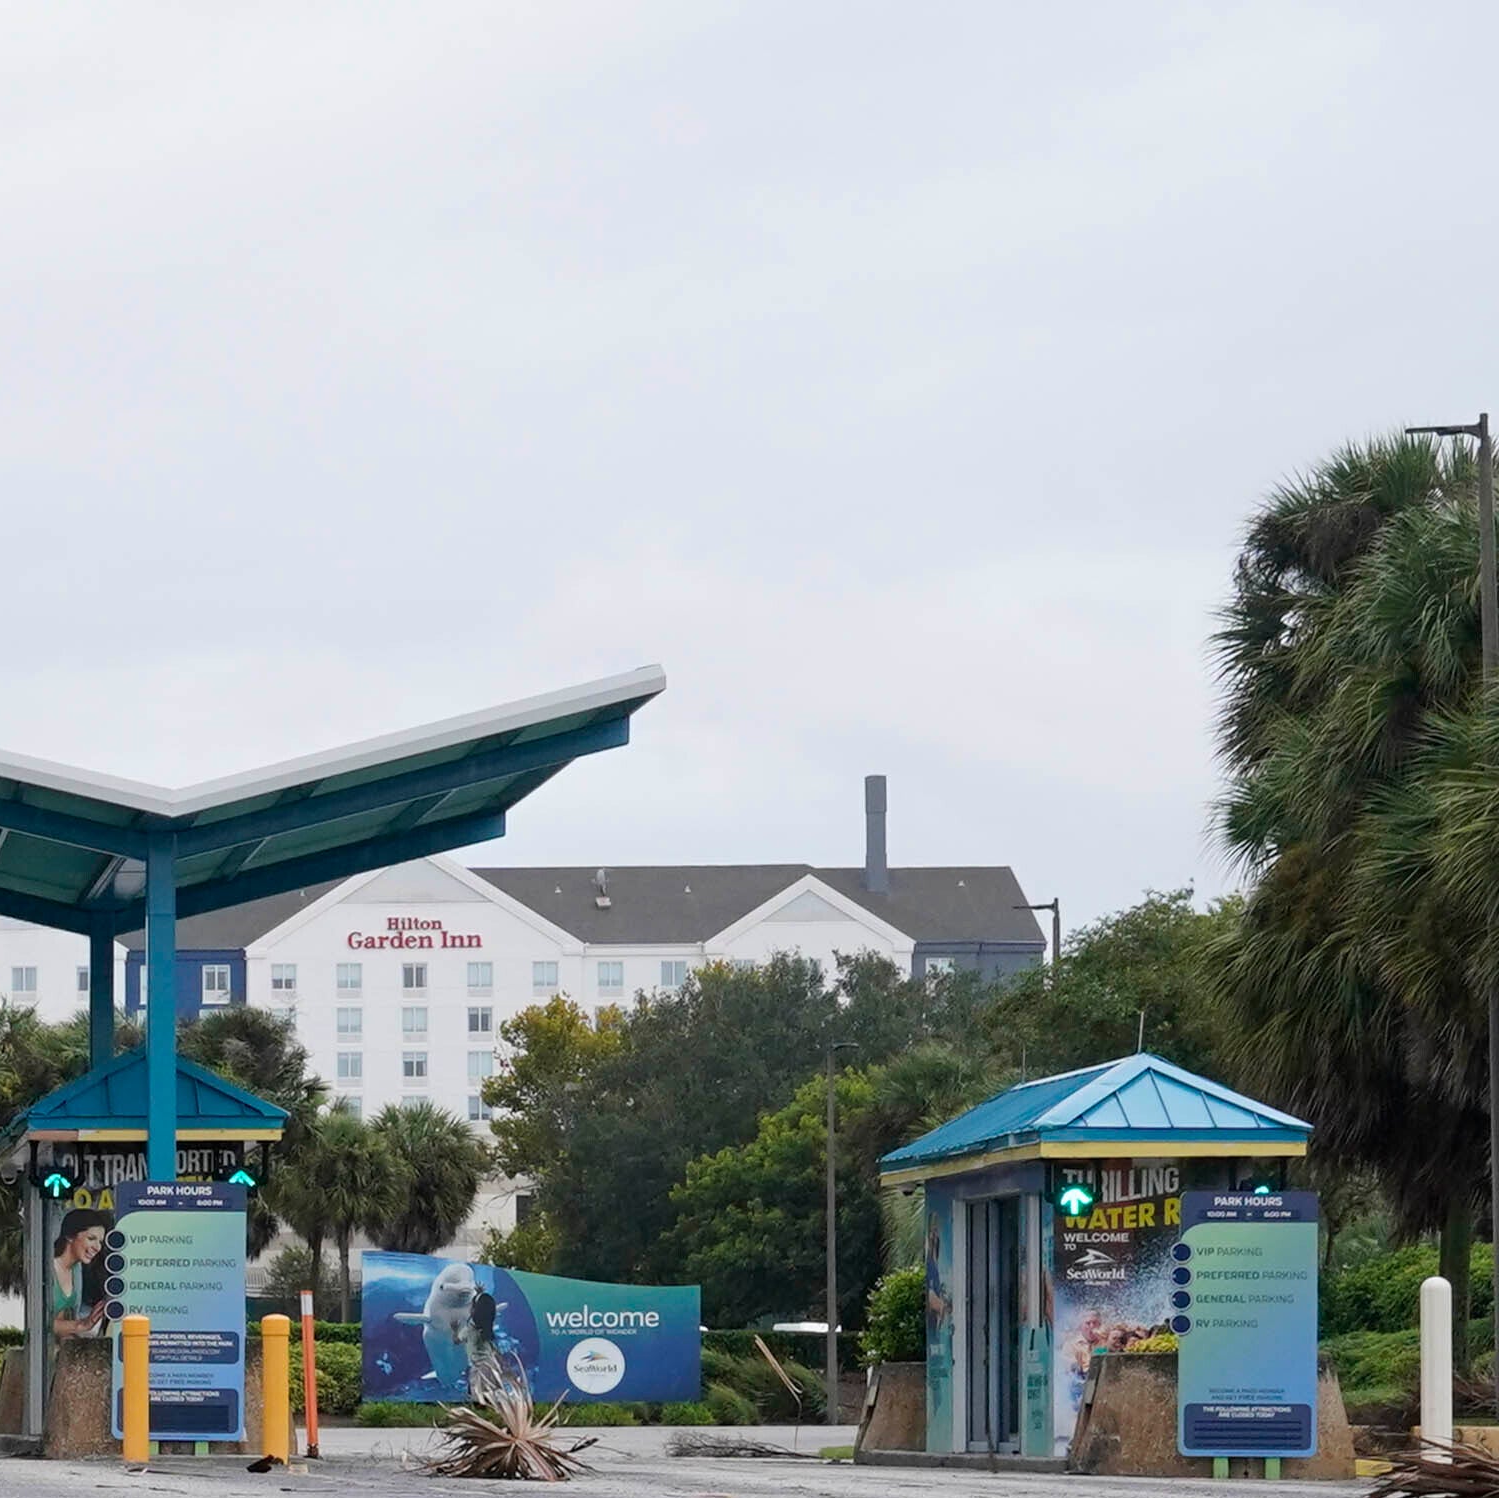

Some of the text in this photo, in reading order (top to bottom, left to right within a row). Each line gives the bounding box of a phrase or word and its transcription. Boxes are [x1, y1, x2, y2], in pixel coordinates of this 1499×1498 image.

[387, 917, 443, 931] Hilton
[347, 931, 482, 950] Garden Inn
[102, 1150, 236, 1182] TRANORTD
[1063, 1167, 1179, 1203] ILLING
[147, 1186, 212, 1195] PARK HOURS
[1214, 1196, 1283, 1206] PARK HOURS
[1065, 1203, 1155, 1230] WATER
[130, 1235, 193, 1244] VIP PARKING
[1063, 1233, 1129, 1242] WELCOME
[1196, 1247, 1263, 1256] VIP PARKING
[130, 1259, 236, 1268] PREFERRED PARKING
[1067, 1268, 1125, 1280] SeaWorld
[1196, 1271, 1307, 1280] PREFERRED PARKING
[129, 1281, 223, 1290] GENERAL PARKING
[1196, 1294, 1294, 1304] GENERAL PARKING
[129, 1305, 188, 1314] RV PARKING
[546, 1304, 660, 1328] welcome
[1196, 1319, 1258, 1328] RV PARKING
[574, 1364, 617, 1373] SeaWorld
